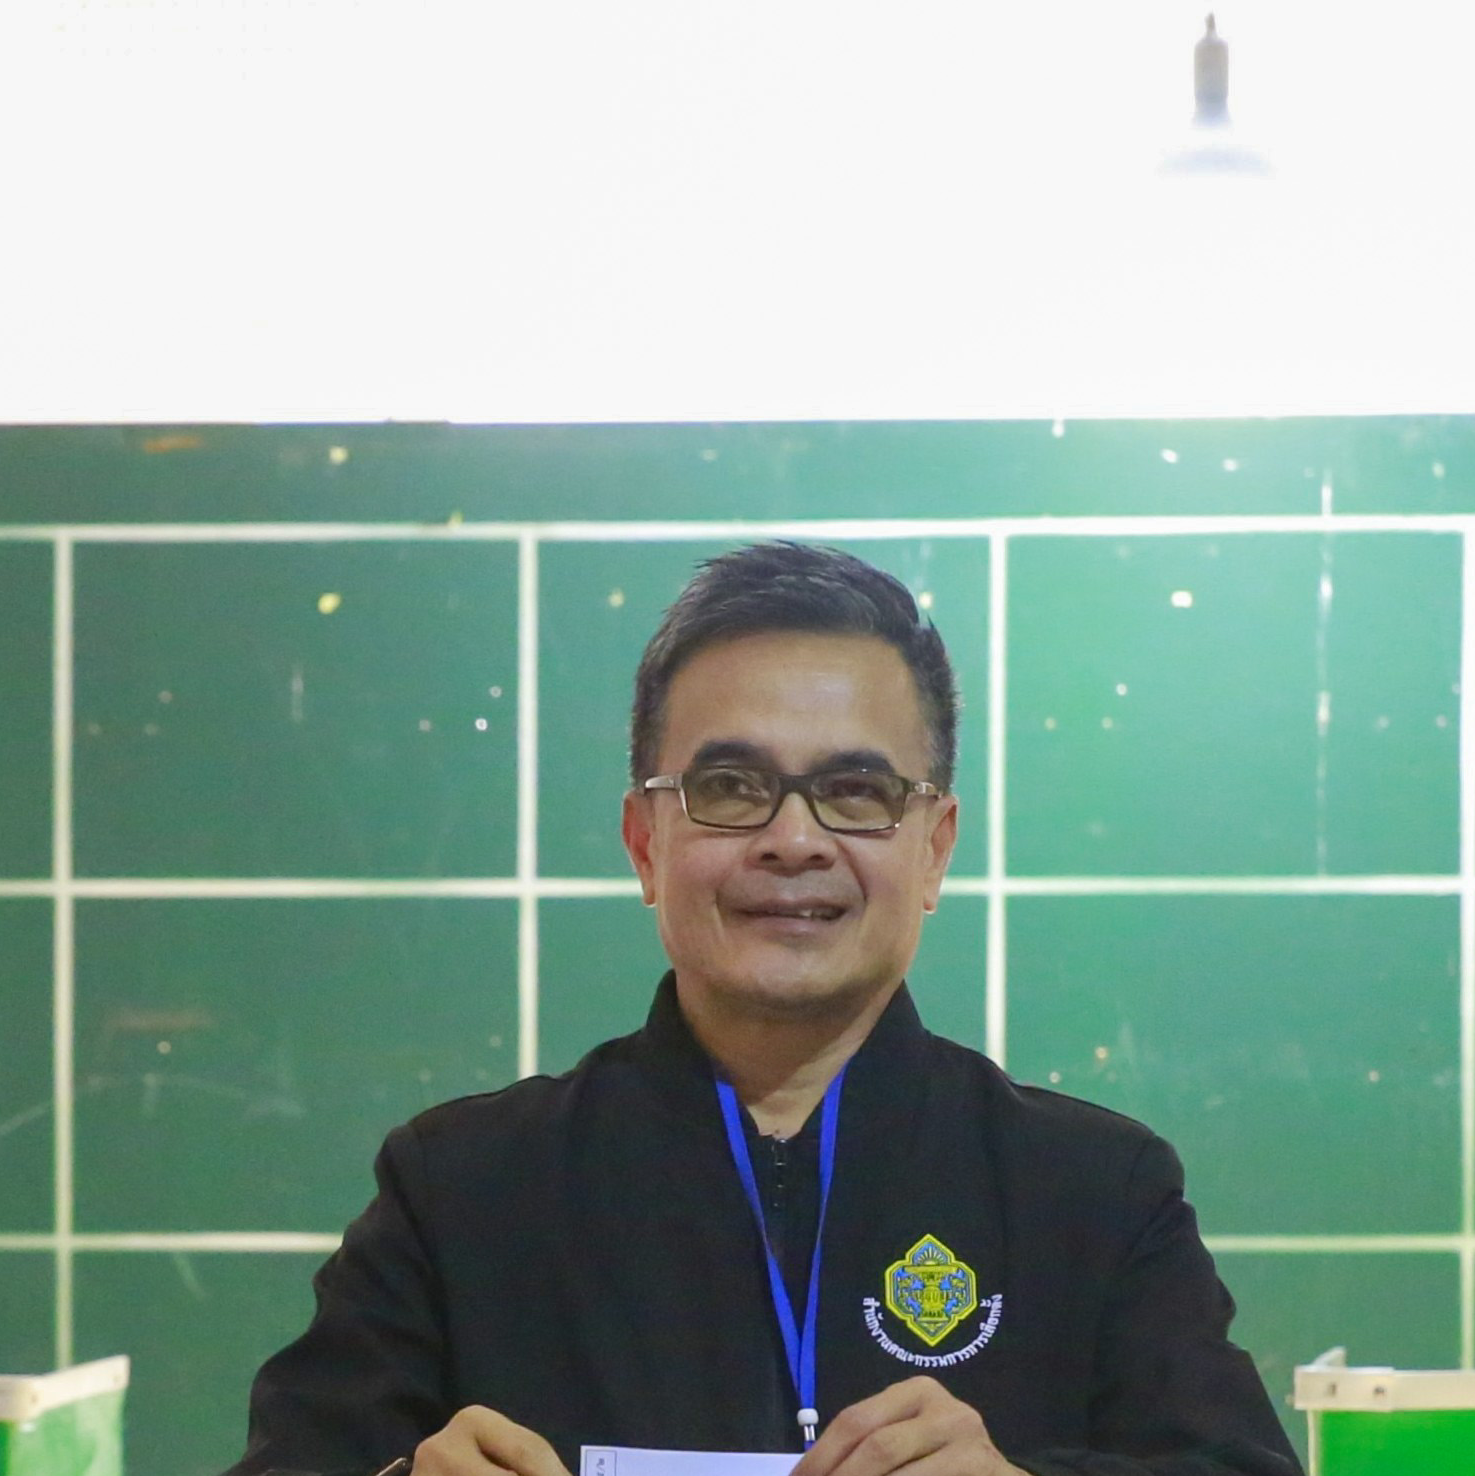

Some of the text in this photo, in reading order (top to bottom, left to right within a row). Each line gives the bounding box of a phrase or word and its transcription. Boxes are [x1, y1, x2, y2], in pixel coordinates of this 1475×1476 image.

[862, 1293, 1004, 1369] สำนักงานคณะกรรมการการเลือกตั้ง
